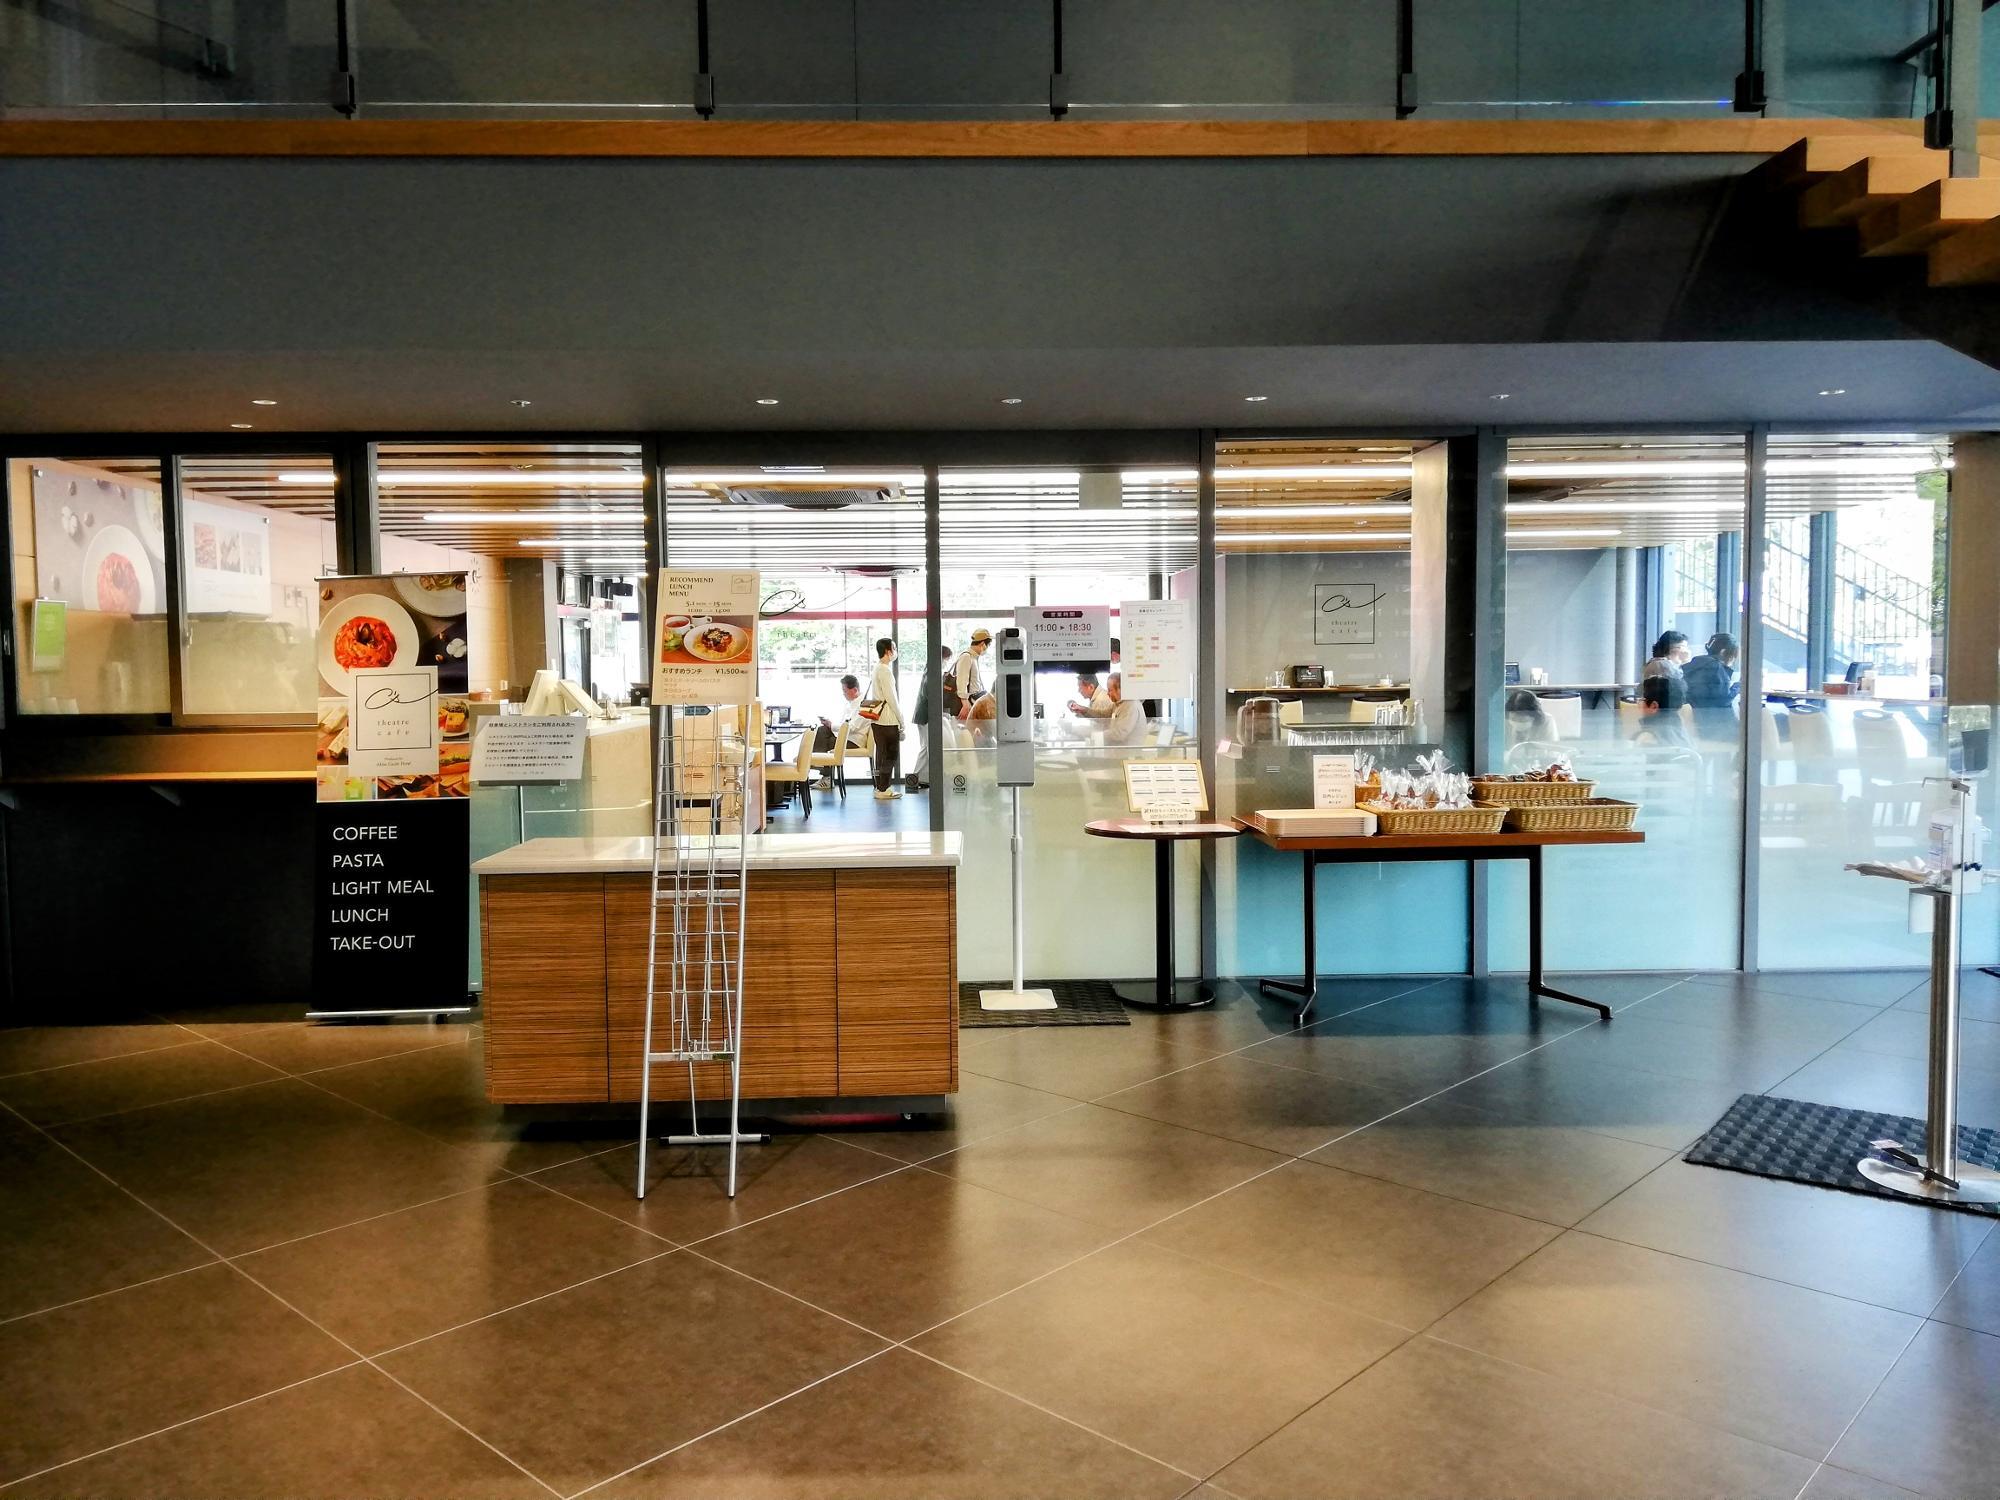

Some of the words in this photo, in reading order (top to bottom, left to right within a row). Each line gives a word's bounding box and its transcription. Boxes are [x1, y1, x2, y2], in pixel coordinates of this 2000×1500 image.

[1034, 623, 1058, 632] 11:00
[1068, 623, 1092, 631] 18:30
[332, 825, 398, 841] COFFEE
[332, 853, 385, 868] PASTA
[332, 881, 382, 896] LIGHT
[387, 879, 435, 894] MEAL
[331, 908, 389, 923] LUNCH
[329, 934, 416, 951] TAKE-OUT
